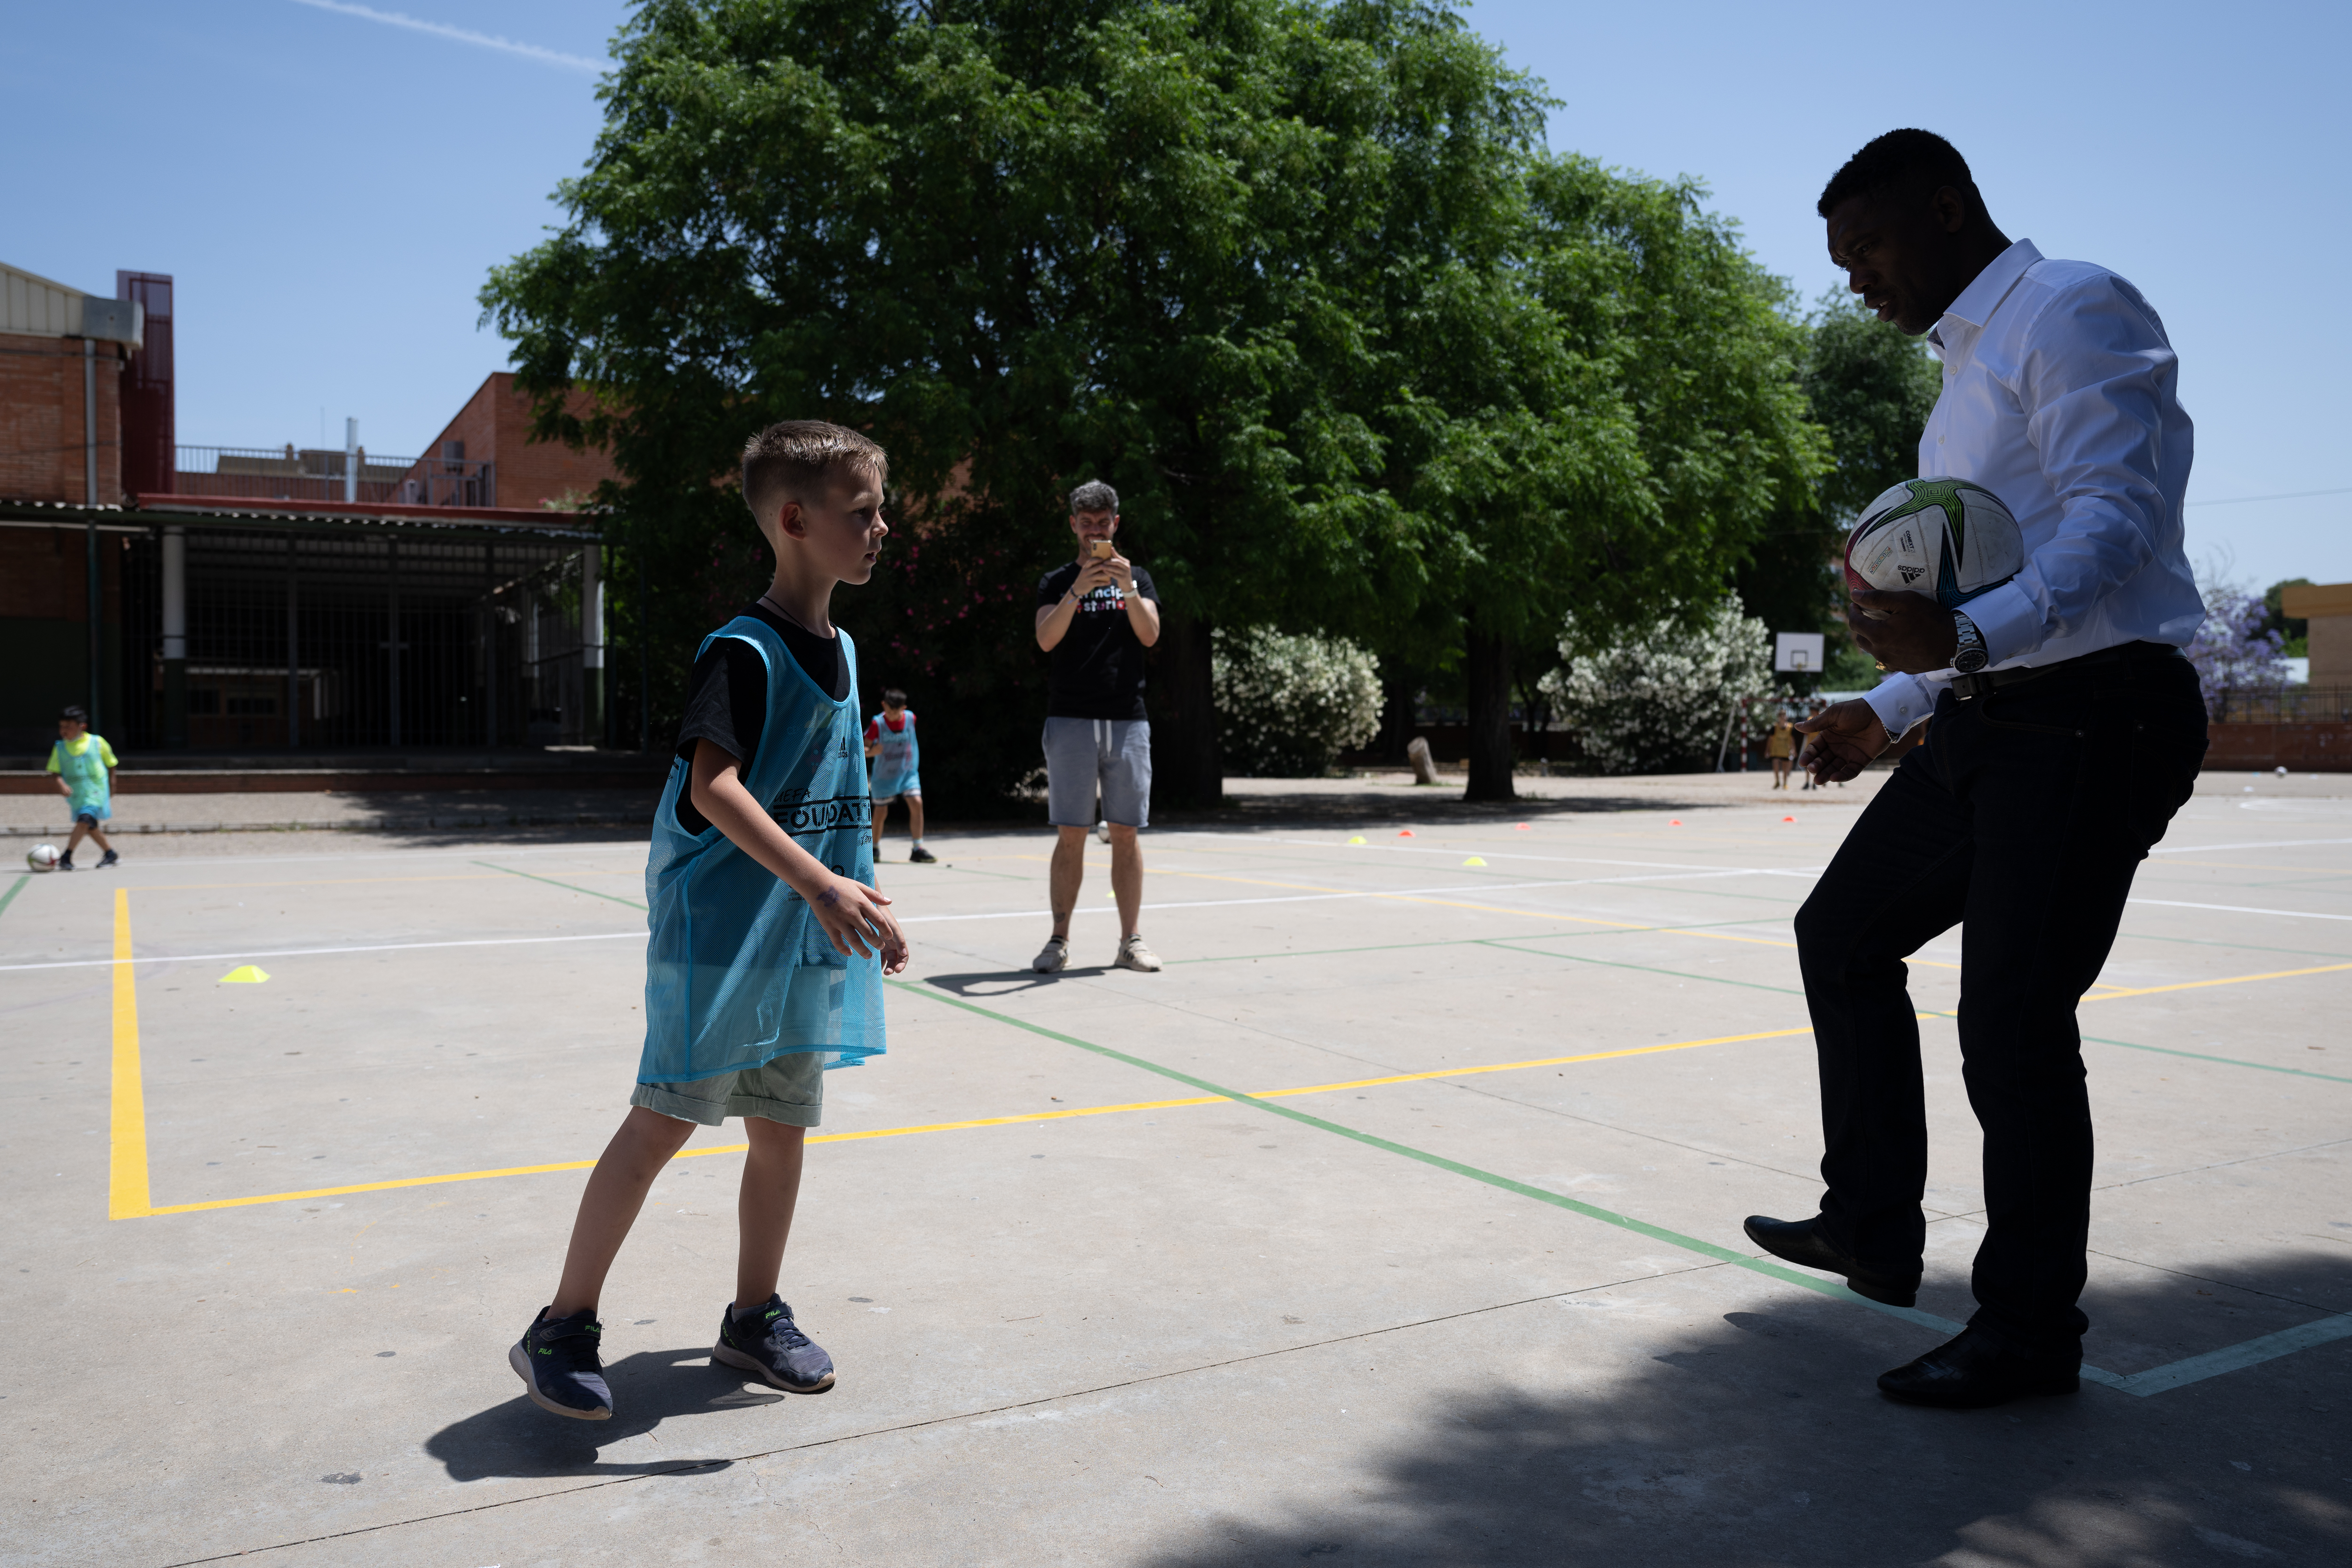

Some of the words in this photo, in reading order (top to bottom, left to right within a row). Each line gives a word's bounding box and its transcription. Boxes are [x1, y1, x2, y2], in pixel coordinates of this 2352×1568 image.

[1906, 530, 1915, 549] CONEXT
[1897, 565, 1925, 574] adidas
[774, 788, 811, 802] UEFA
[765, 1309, 781, 1319] FILA
